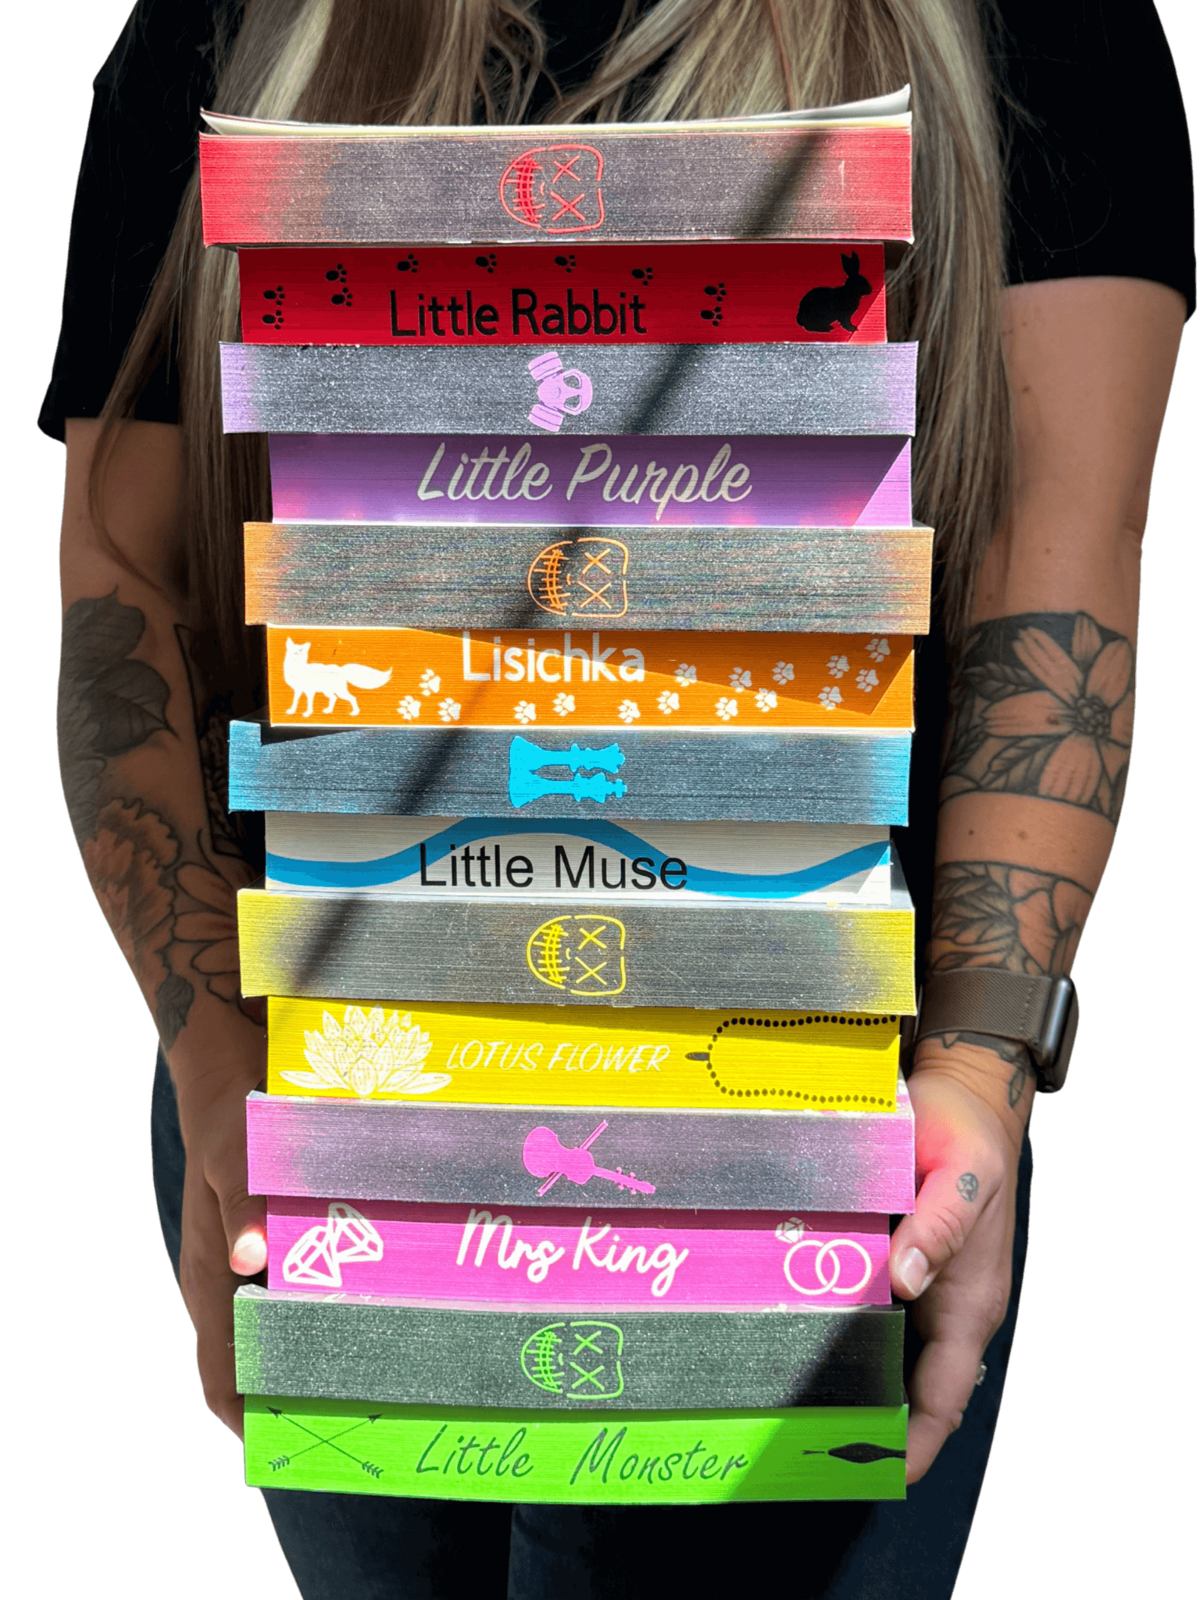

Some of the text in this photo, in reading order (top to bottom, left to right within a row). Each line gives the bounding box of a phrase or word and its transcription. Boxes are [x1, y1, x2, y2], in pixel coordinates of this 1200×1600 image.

[390, 289, 647, 338] Little Rabbit
[417, 443, 753, 522] Little Purple
[463, 632, 645, 683] Lisichka
[421, 843, 689, 891] Little Muse
[446, 1040, 671, 1074] LOTUS FLOWER
[456, 1209, 690, 1298] Mrs King
[416, 1424, 749, 1487] Little Monster
